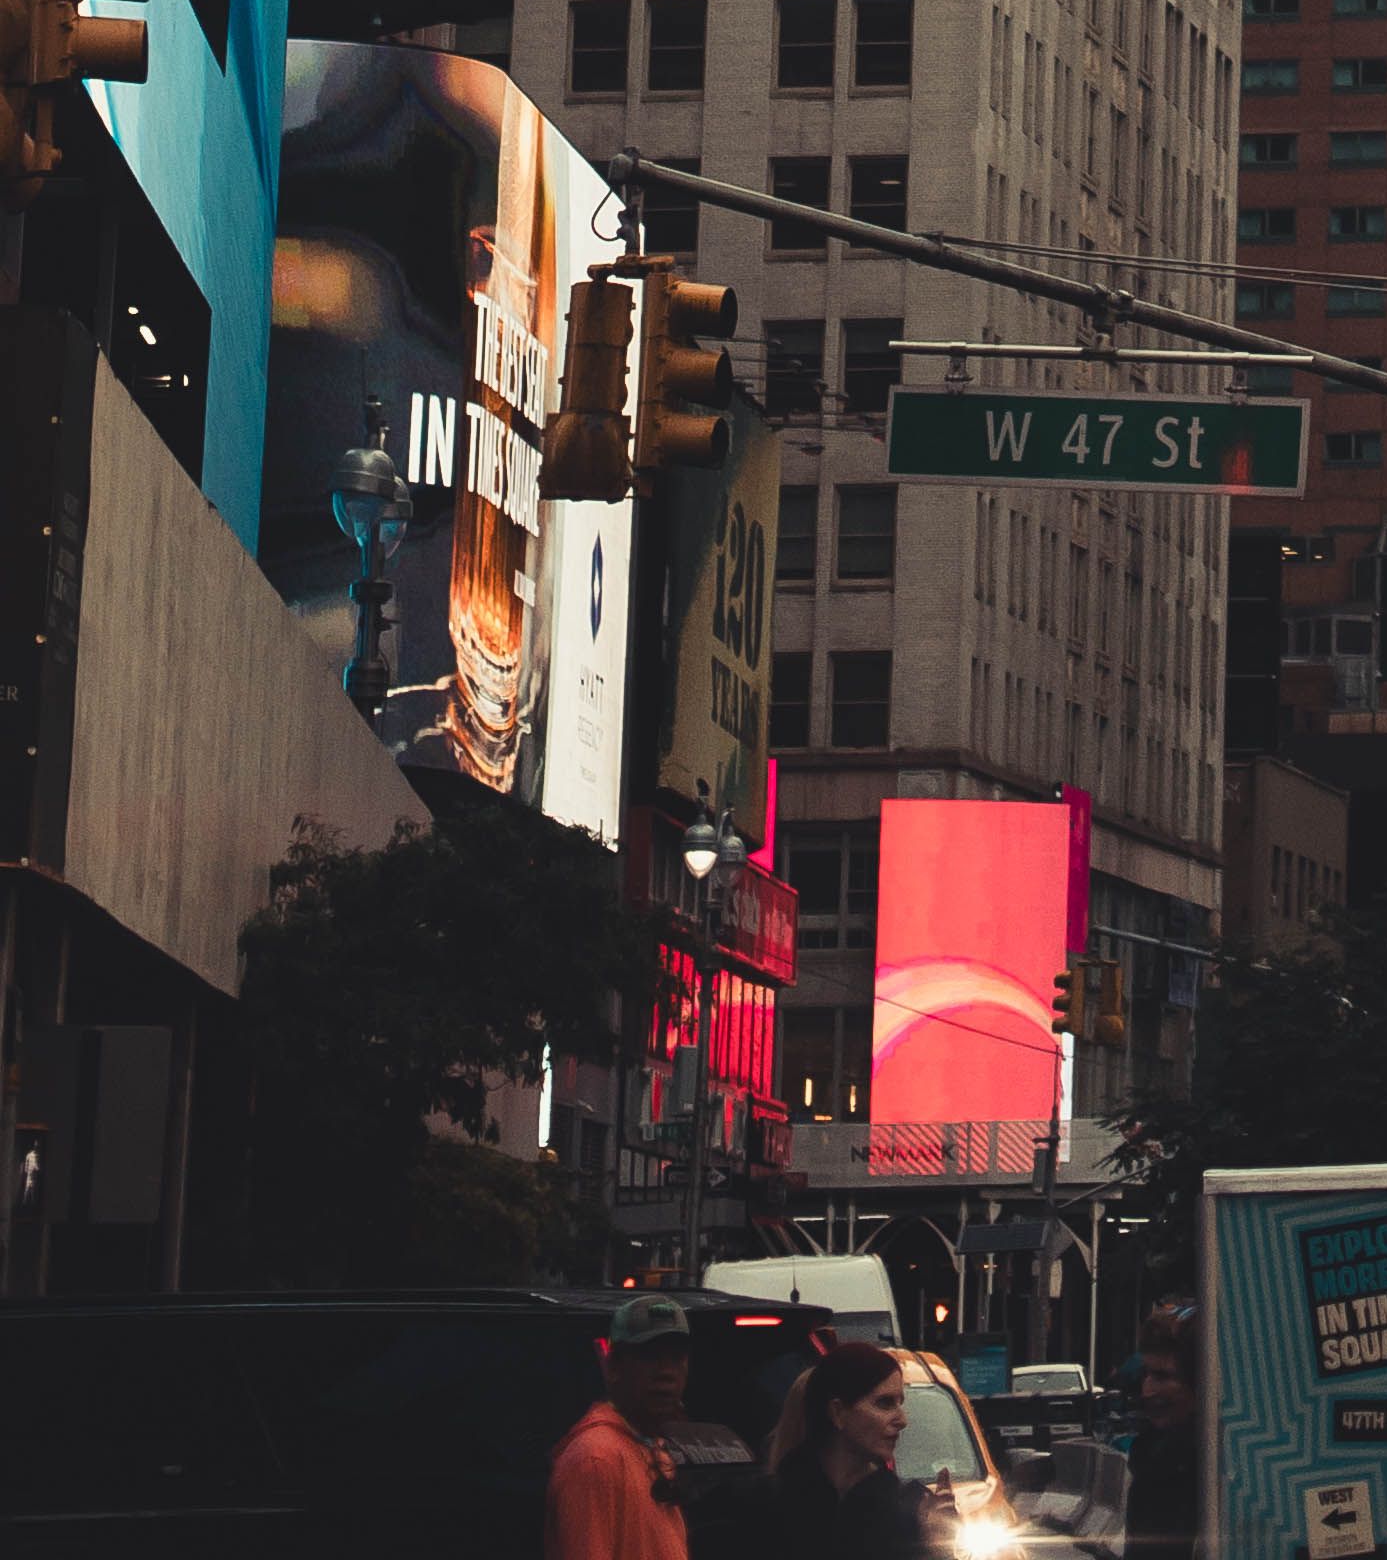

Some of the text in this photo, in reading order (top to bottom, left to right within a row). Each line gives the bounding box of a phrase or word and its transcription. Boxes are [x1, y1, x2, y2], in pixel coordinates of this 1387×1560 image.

[407, 391, 457, 488] IN
[465, 401, 506, 510] TIMES
[985, 410, 1205, 470] W 47 St
[1315, 1301, 1349, 1336] IN
[1342, 1410, 1385, 1431] 47TH
[1317, 1486, 1355, 1506] WEST
